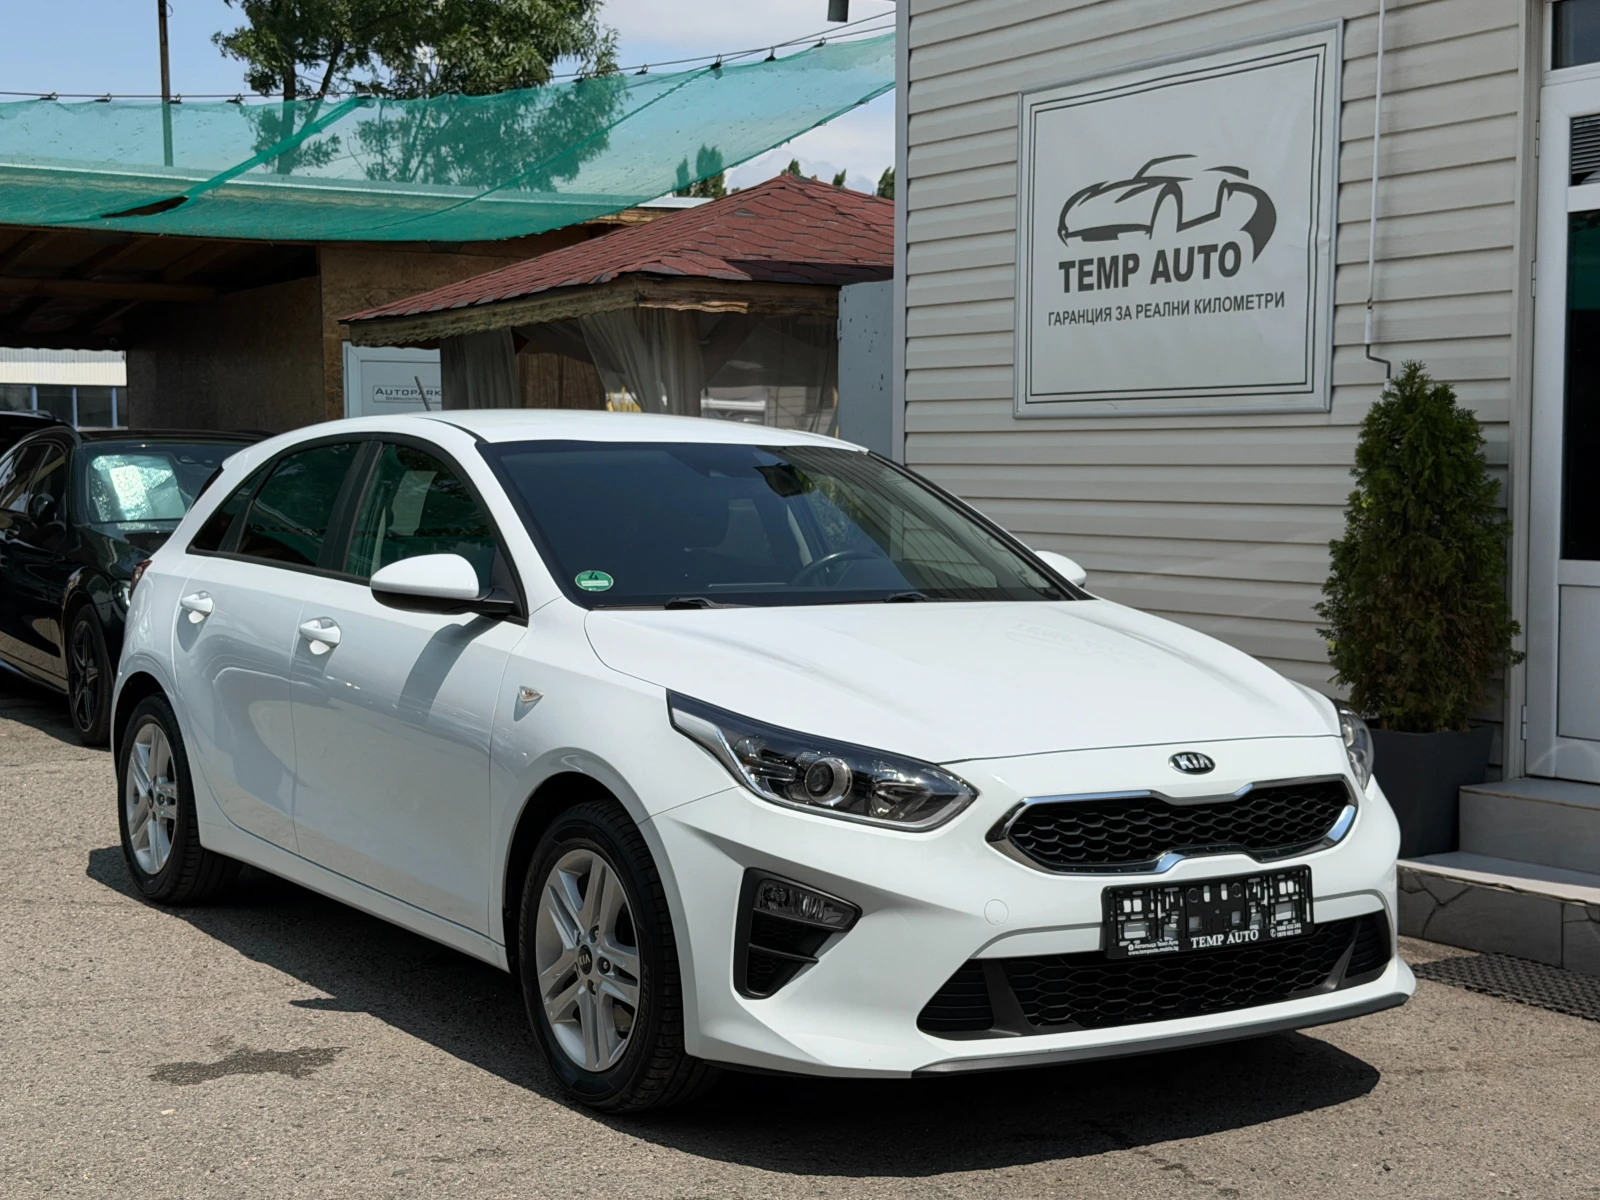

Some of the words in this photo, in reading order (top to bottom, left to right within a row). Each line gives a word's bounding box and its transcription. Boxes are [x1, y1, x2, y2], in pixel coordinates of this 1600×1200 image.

[1058, 253, 1140, 293] TEMP
[1150, 241, 1242, 285] AUTO
[1048, 307, 1112, 326] ГАРАНЦИЯ
[1116, 305, 1132, 321] ЗА
[1136, 300, 1190, 320] РЕАЛНИ
[1194, 291, 1285, 315] КИЛОМЕТРИ
[1175, 754, 1212, 769] KIA
[1190, 933, 1225, 949] TEMP
[1226, 929, 1259, 944] AUTO
